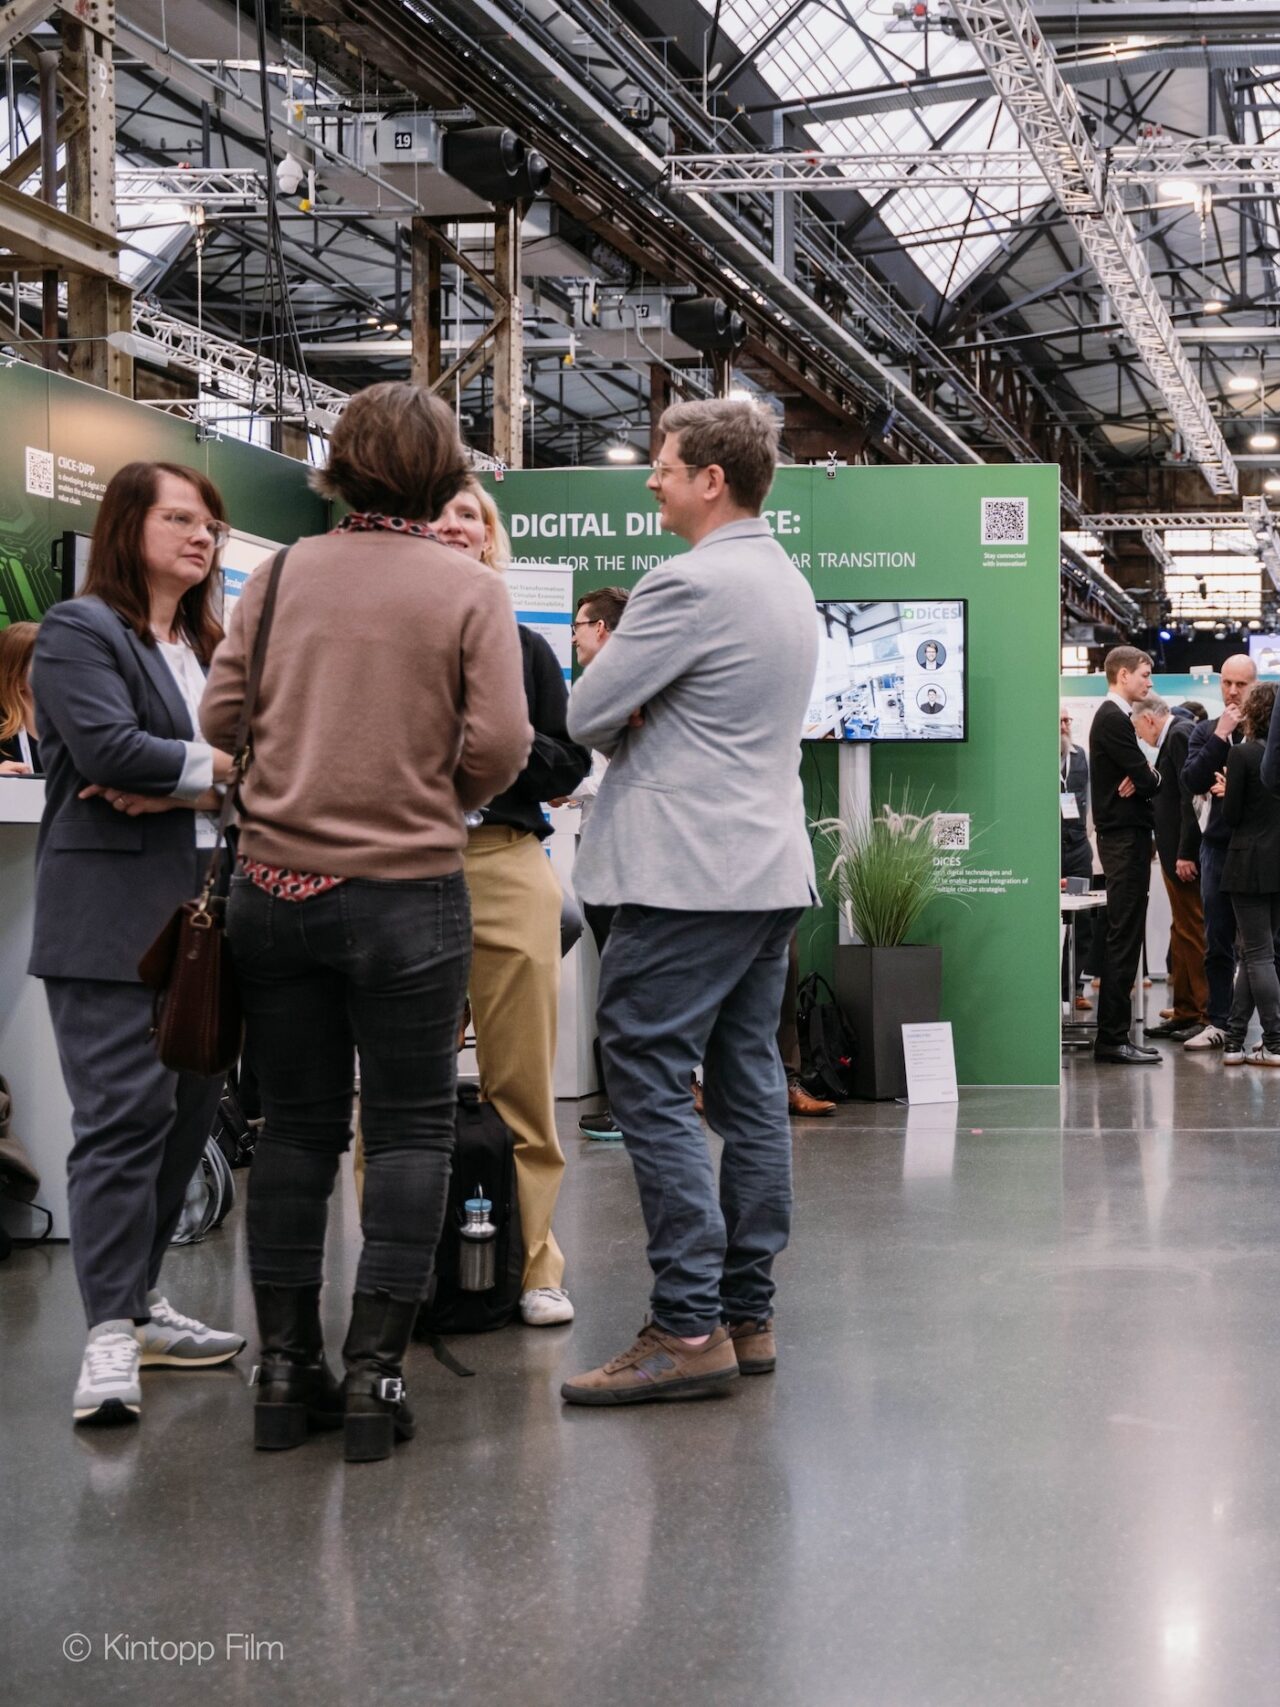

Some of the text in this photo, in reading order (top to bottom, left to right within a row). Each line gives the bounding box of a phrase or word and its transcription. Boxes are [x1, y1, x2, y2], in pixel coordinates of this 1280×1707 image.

[396, 134, 411, 148] 19
[511, 513, 616, 538] DIGITAL
[558, 556, 589, 571] FOR
[594, 556, 625, 571] THE
[818, 552, 916, 568] TRANSITION
[965, 869, 1000, 877] technologies
